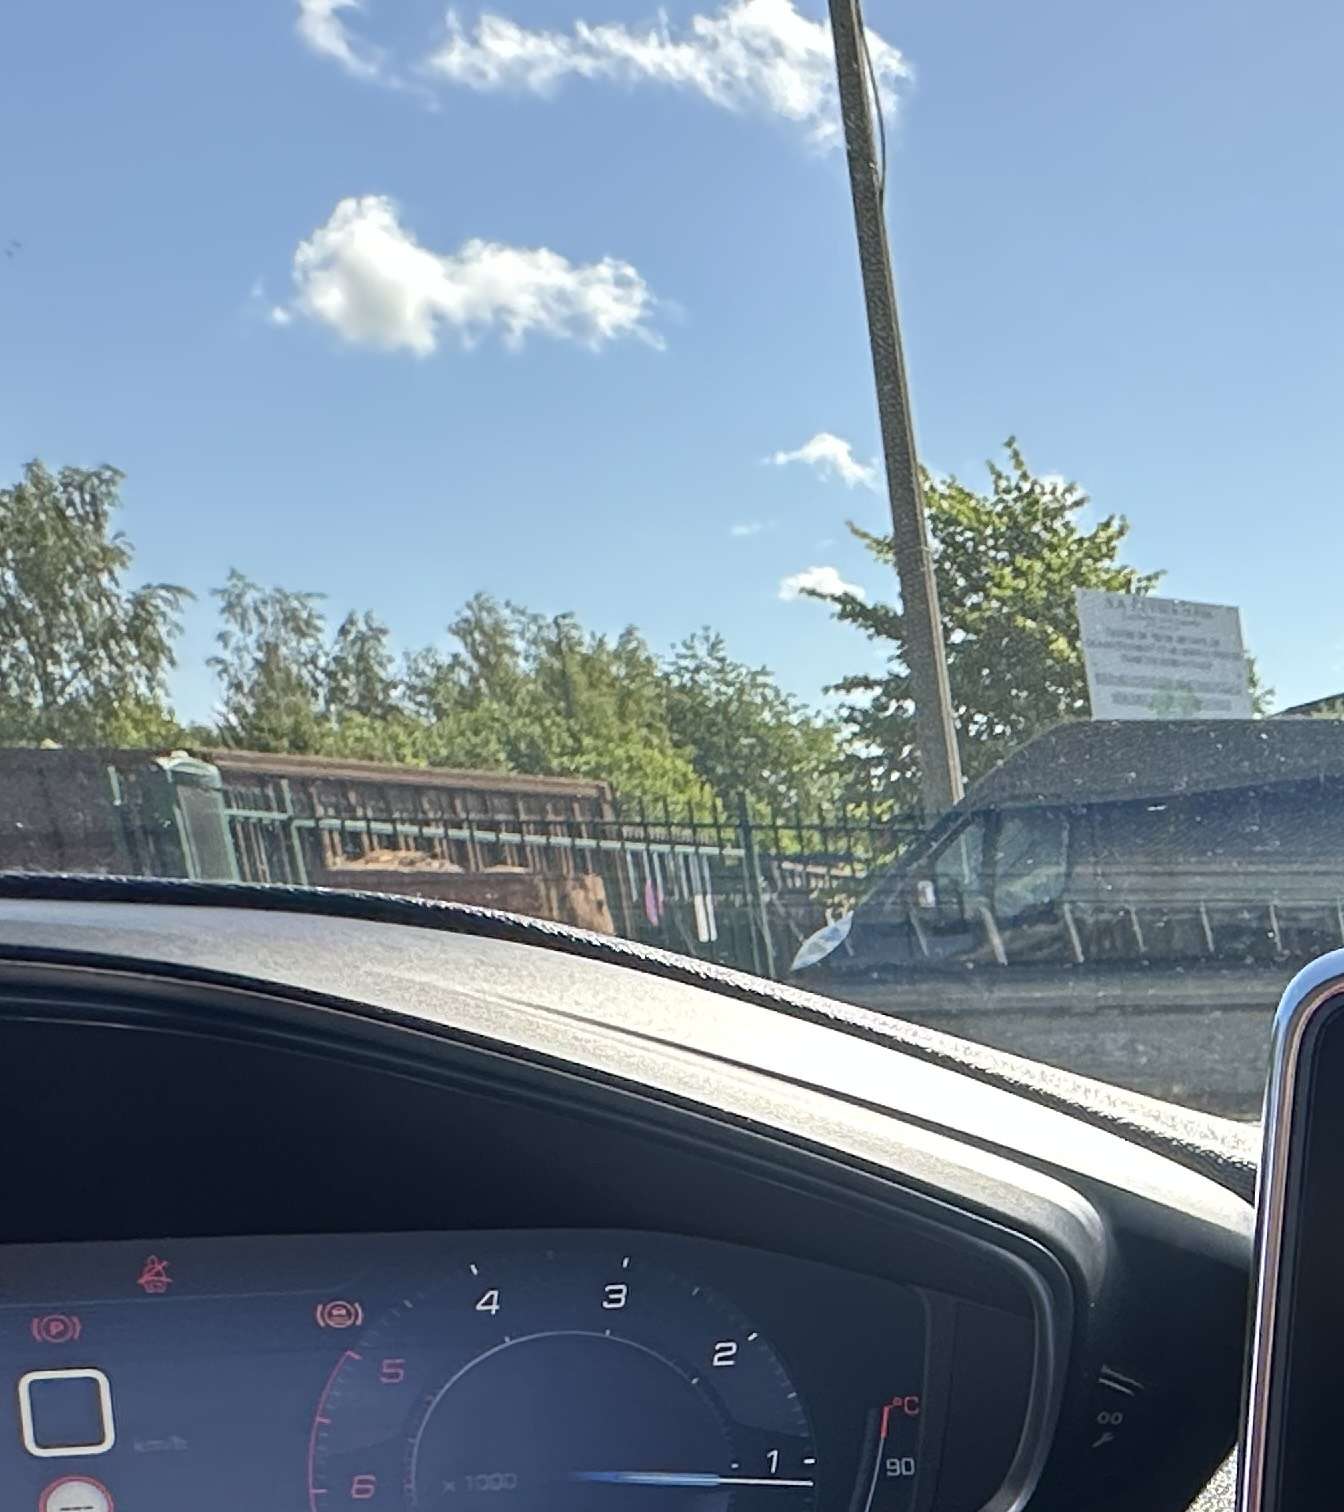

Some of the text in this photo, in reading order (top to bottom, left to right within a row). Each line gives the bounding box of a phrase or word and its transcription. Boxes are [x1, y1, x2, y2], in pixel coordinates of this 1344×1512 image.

[476, 1290, 500, 1315] 4
[602, 1284, 628, 1309] 3
[713, 1341, 738, 1367] 2
[379, 1359, 405, 1384] 5
[766, 1449, 779, 1474] 1
[885, 1457, 915, 1476] 90
[351, 1474, 377, 1499] 6
